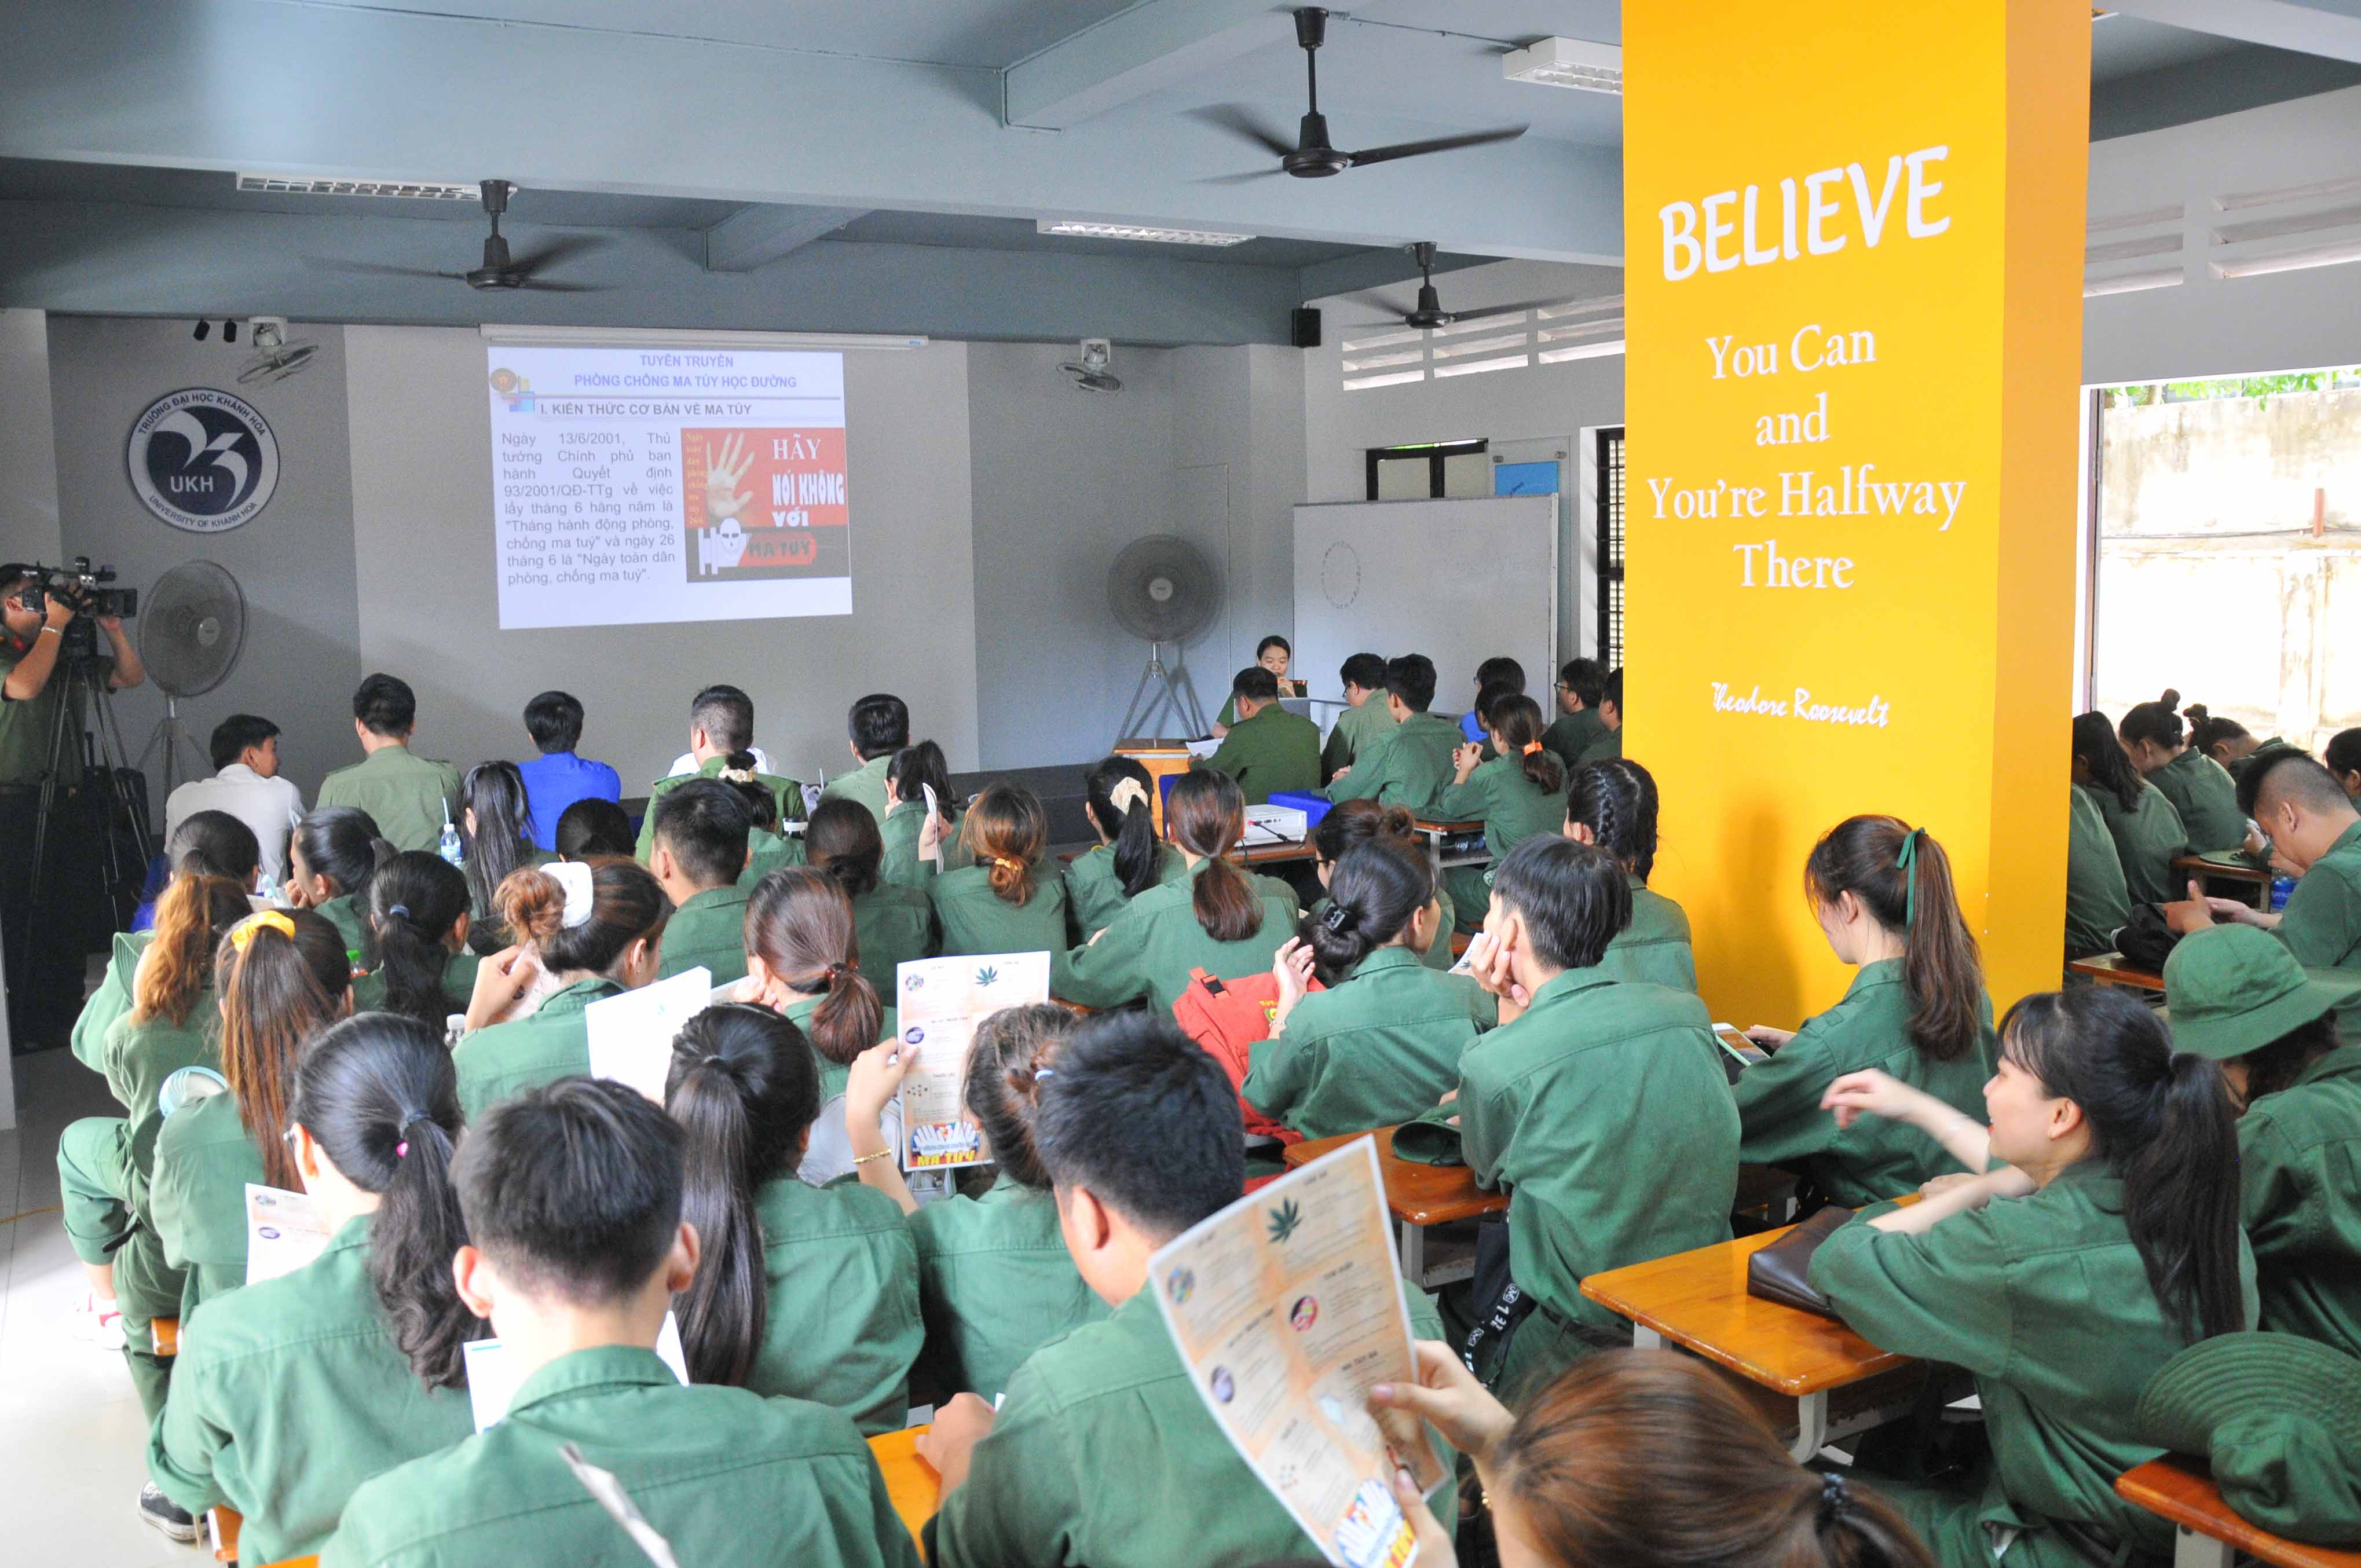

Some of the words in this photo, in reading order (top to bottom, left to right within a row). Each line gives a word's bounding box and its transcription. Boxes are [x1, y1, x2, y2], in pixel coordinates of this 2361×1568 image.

[1659, 145, 1950, 280] BELIEVE
[1706, 336, 1778, 379] You
[1791, 325, 1876, 371] Can
[673, 376, 692, 387] MA
[722, 376, 748, 390] HỌC
[192, 393, 214, 402] HỌC
[629, 404, 650, 415] CƠ
[704, 404, 724, 415] MA
[1756, 392, 1830, 446] and
[502, 431, 536, 446] Ngày
[559, 432, 625, 446] 13/6/2001,
[773, 433, 821, 460] HÃY
[558, 450, 596, 462] Chính
[648, 450, 672, 461] ban
[170, 475, 214, 493] UKH
[773, 469, 796, 506] NÓI
[799, 469, 845, 505] KHÔNG
[1647, 478, 1767, 519] You're
[1778, 464, 1966, 531] Halfway
[149, 495, 195, 526] UNIVERSITY
[197, 519, 208, 527] OF
[212, 513, 241, 527] KHANH
[240, 501, 258, 517] HOA
[574, 501, 583, 514] 6
[551, 540, 571, 549] ma
[659, 533, 675, 546] 26
[548, 554, 557, 566] 6
[1733, 540, 1853, 588] There
[599, 571, 619, 581] ma
[1712, 682, 1788, 716] Theodore
[1794, 688, 1889, 728] Roosevelt
